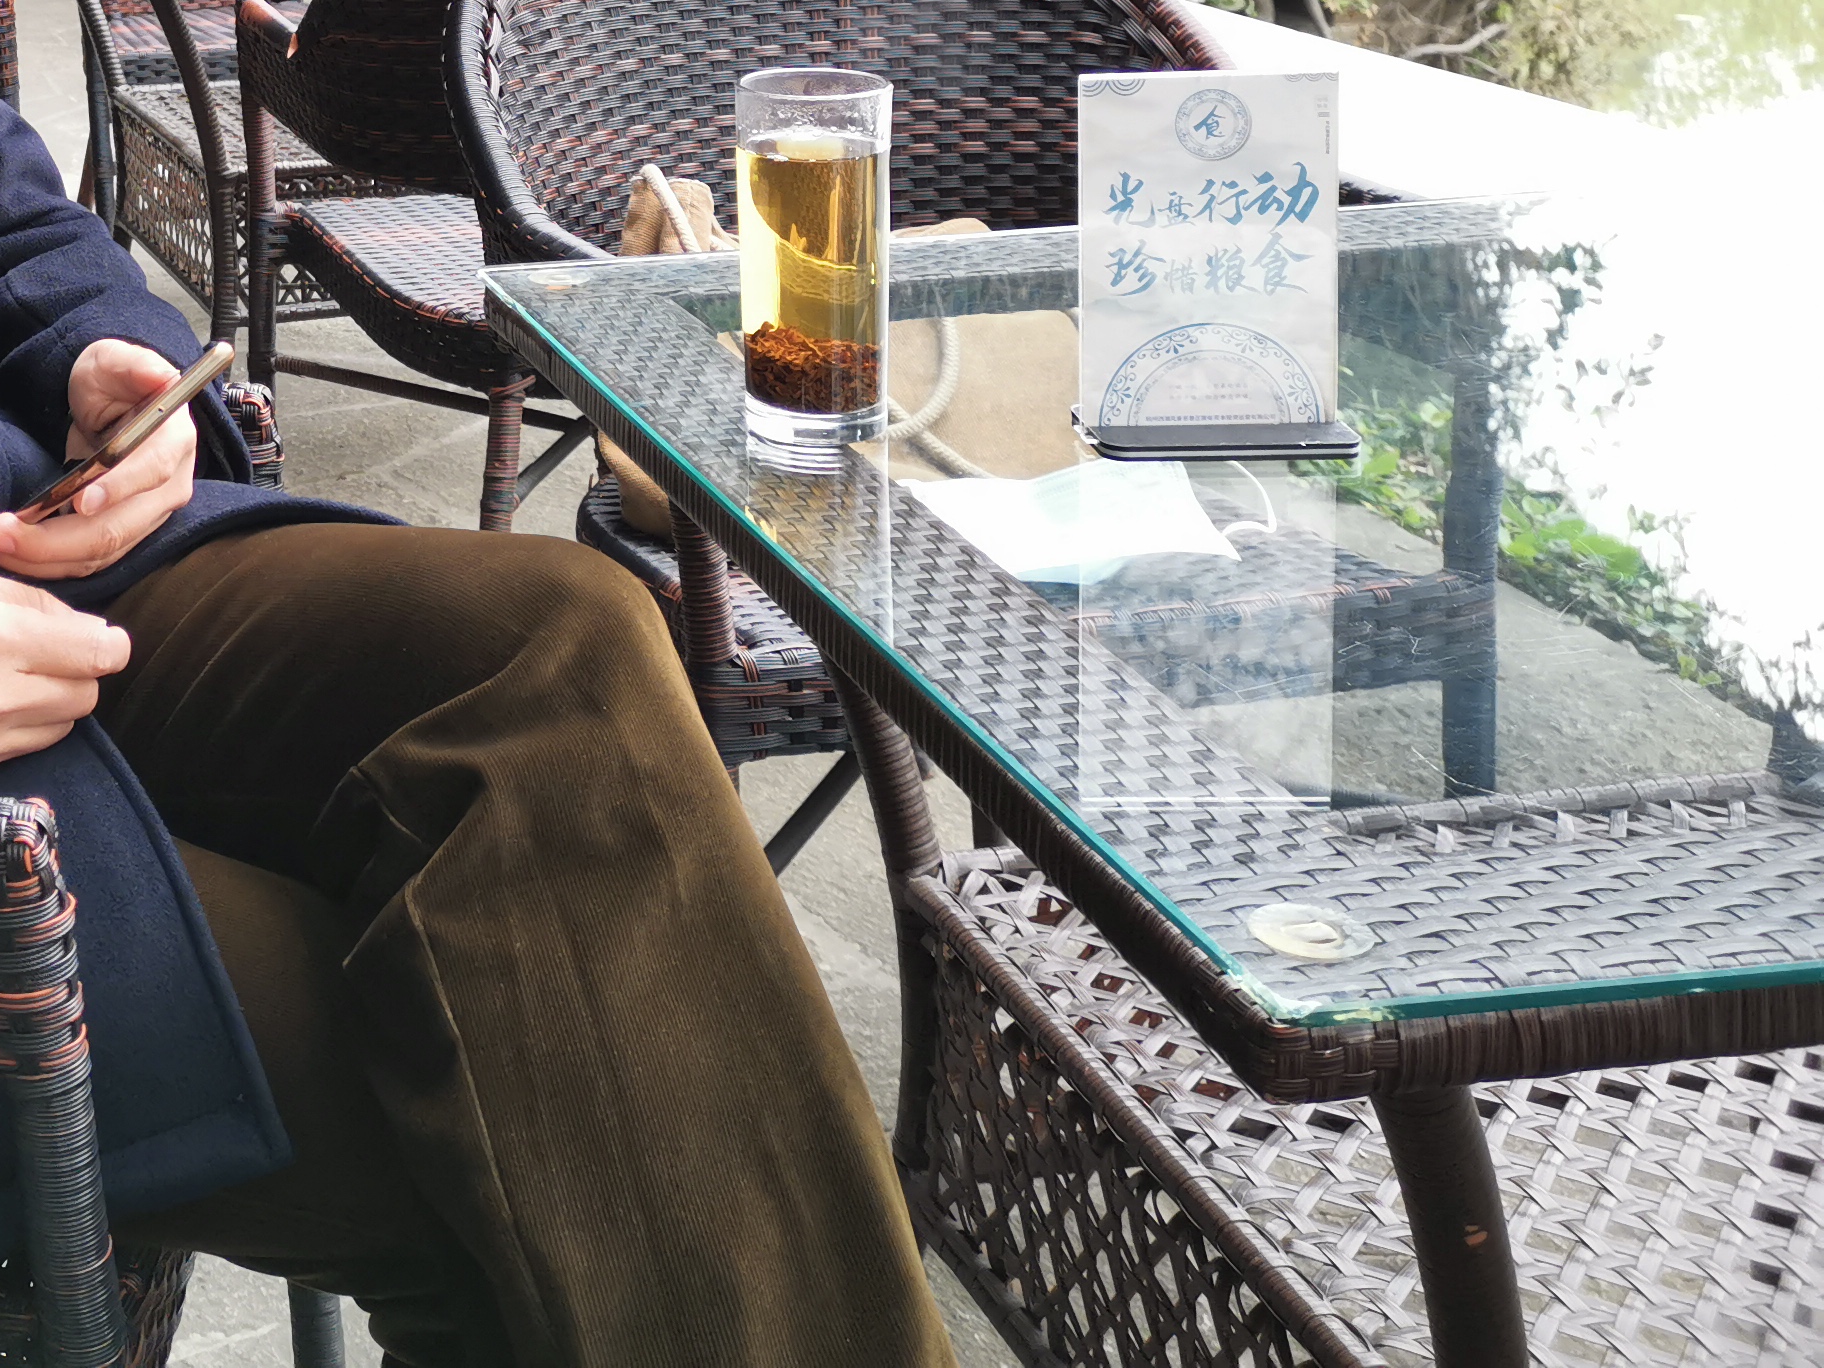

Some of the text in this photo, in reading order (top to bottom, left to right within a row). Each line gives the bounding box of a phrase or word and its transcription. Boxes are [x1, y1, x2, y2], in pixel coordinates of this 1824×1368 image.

[1192, 105, 1227, 139] 食
[1102, 161, 1320, 229] 光盘行动
[1104, 232, 1316, 297] 珍惜粮食
